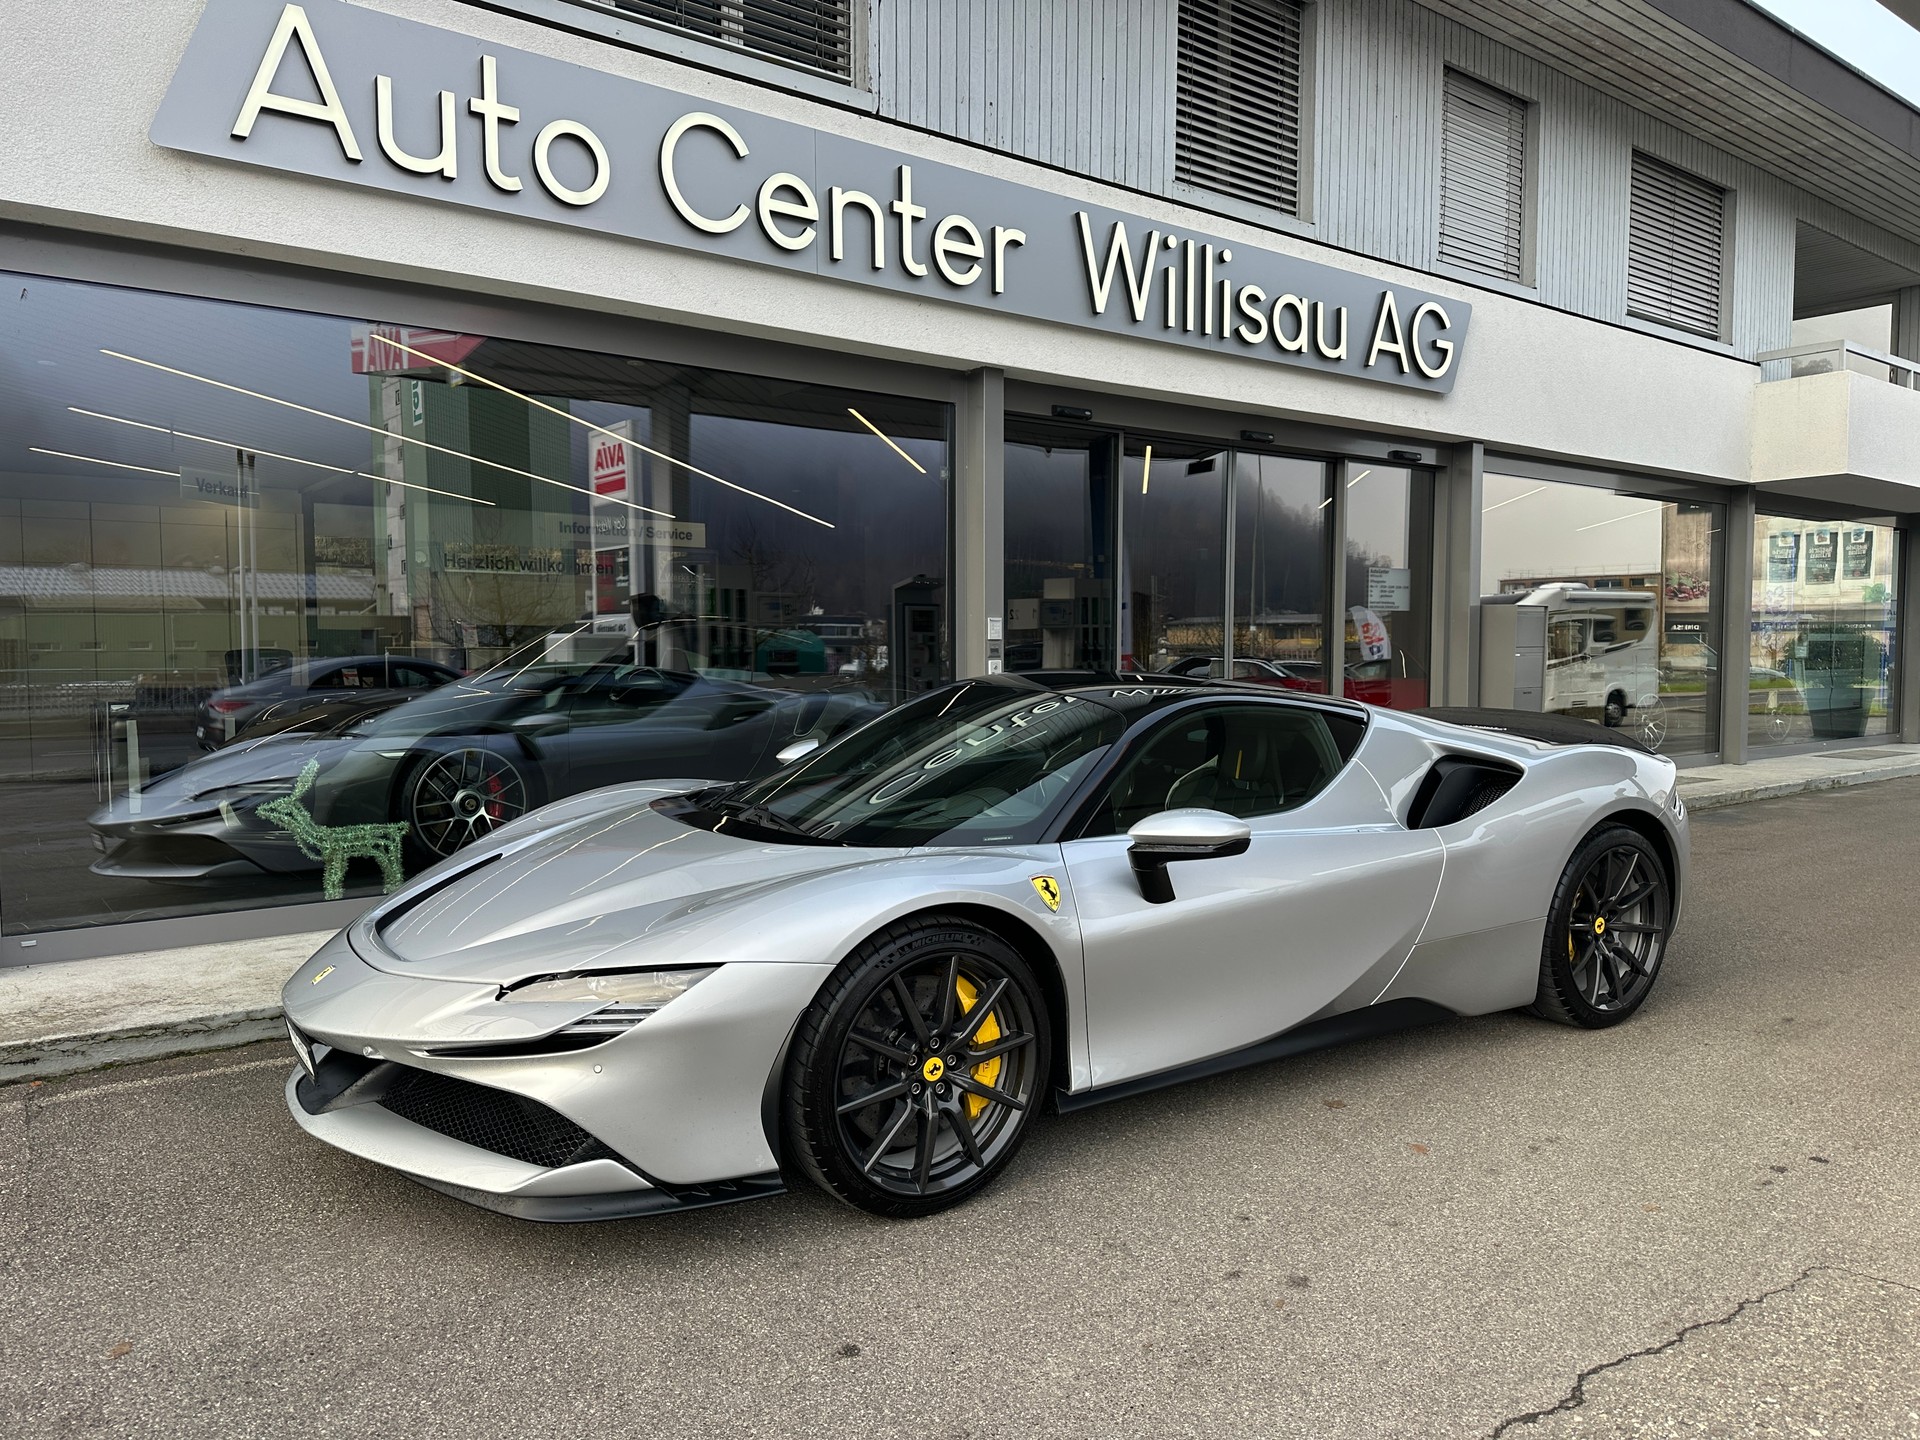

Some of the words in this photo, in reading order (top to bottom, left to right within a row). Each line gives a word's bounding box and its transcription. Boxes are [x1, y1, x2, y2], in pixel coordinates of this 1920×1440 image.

[230, 3, 611, 207] Auto
[658, 111, 1026, 295] Center
[1075, 210, 1348, 361] Willisau
[1364, 289, 1455, 380] AG
[195, 477, 248, 498] Verkauf
[645, 526, 693, 541] Service
[444, 552, 515, 571] Herzlich
[912, 933, 963, 948] MICHELIN
